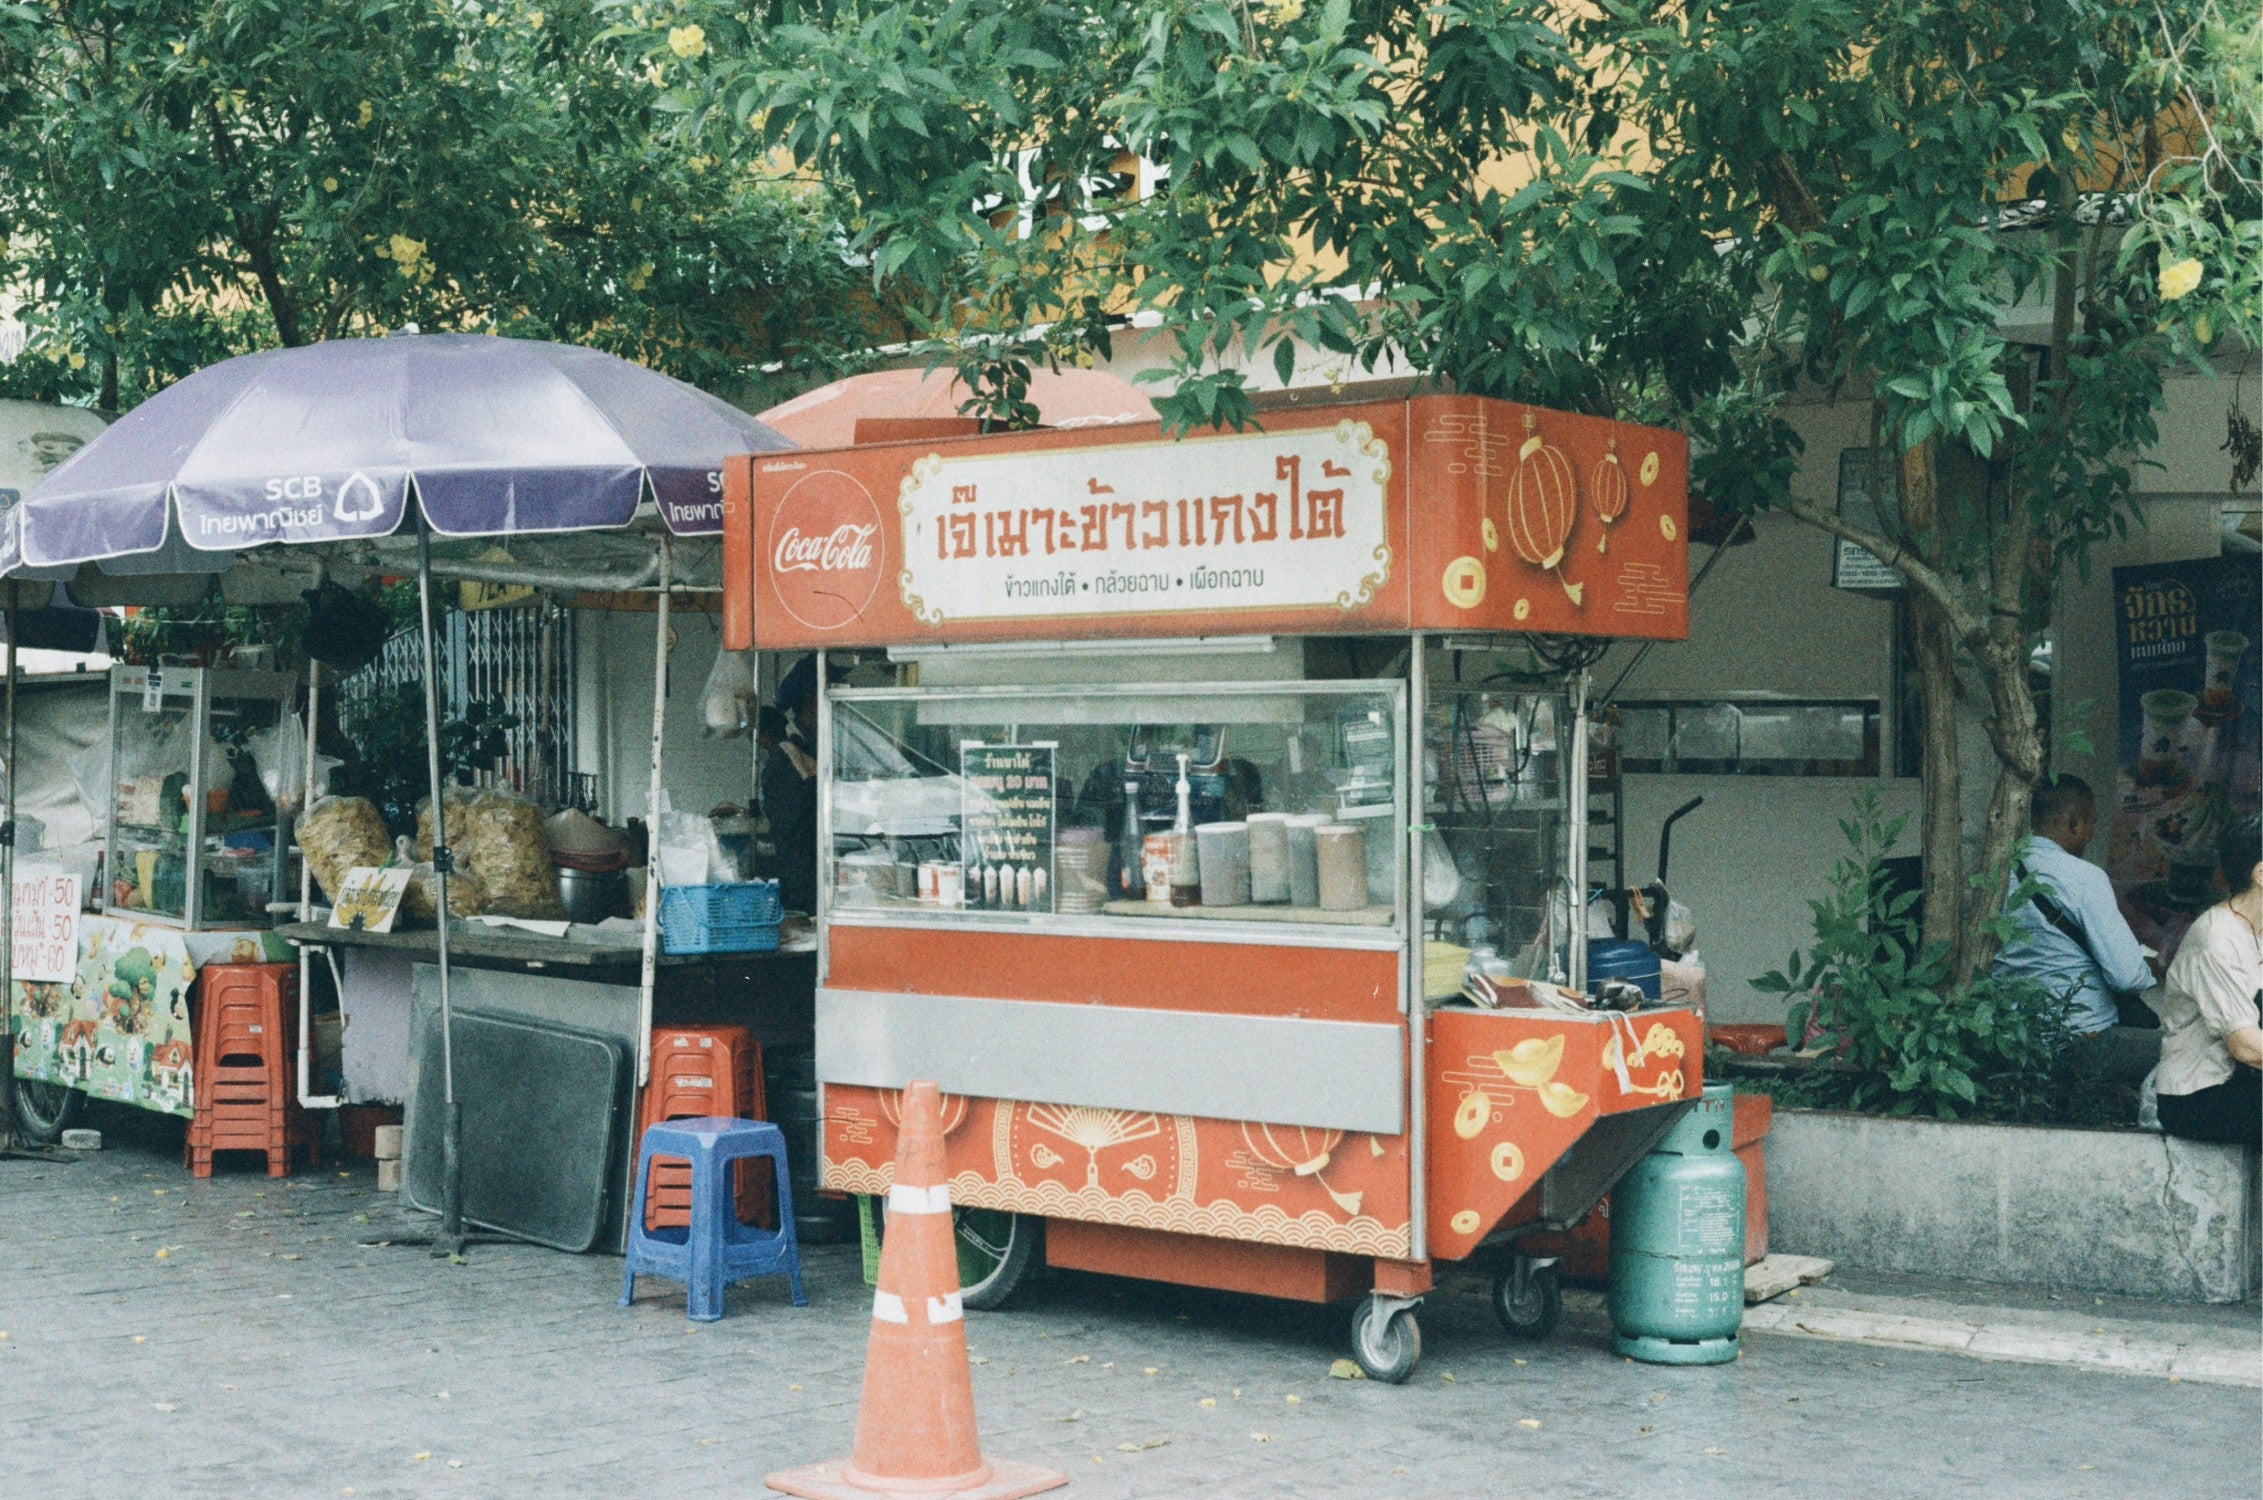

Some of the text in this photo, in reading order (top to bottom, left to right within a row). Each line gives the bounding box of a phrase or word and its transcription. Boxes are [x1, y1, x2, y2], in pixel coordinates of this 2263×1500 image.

[265, 475, 322, 501] SCB
[199, 504, 324, 535] ไทยพาณิชย์
[775, 523, 878, 573] Coca-Cola
[1004, 564, 1265, 598] ข้าวแกงใต้ กล้วยฉาบ เผือกฉาบ
